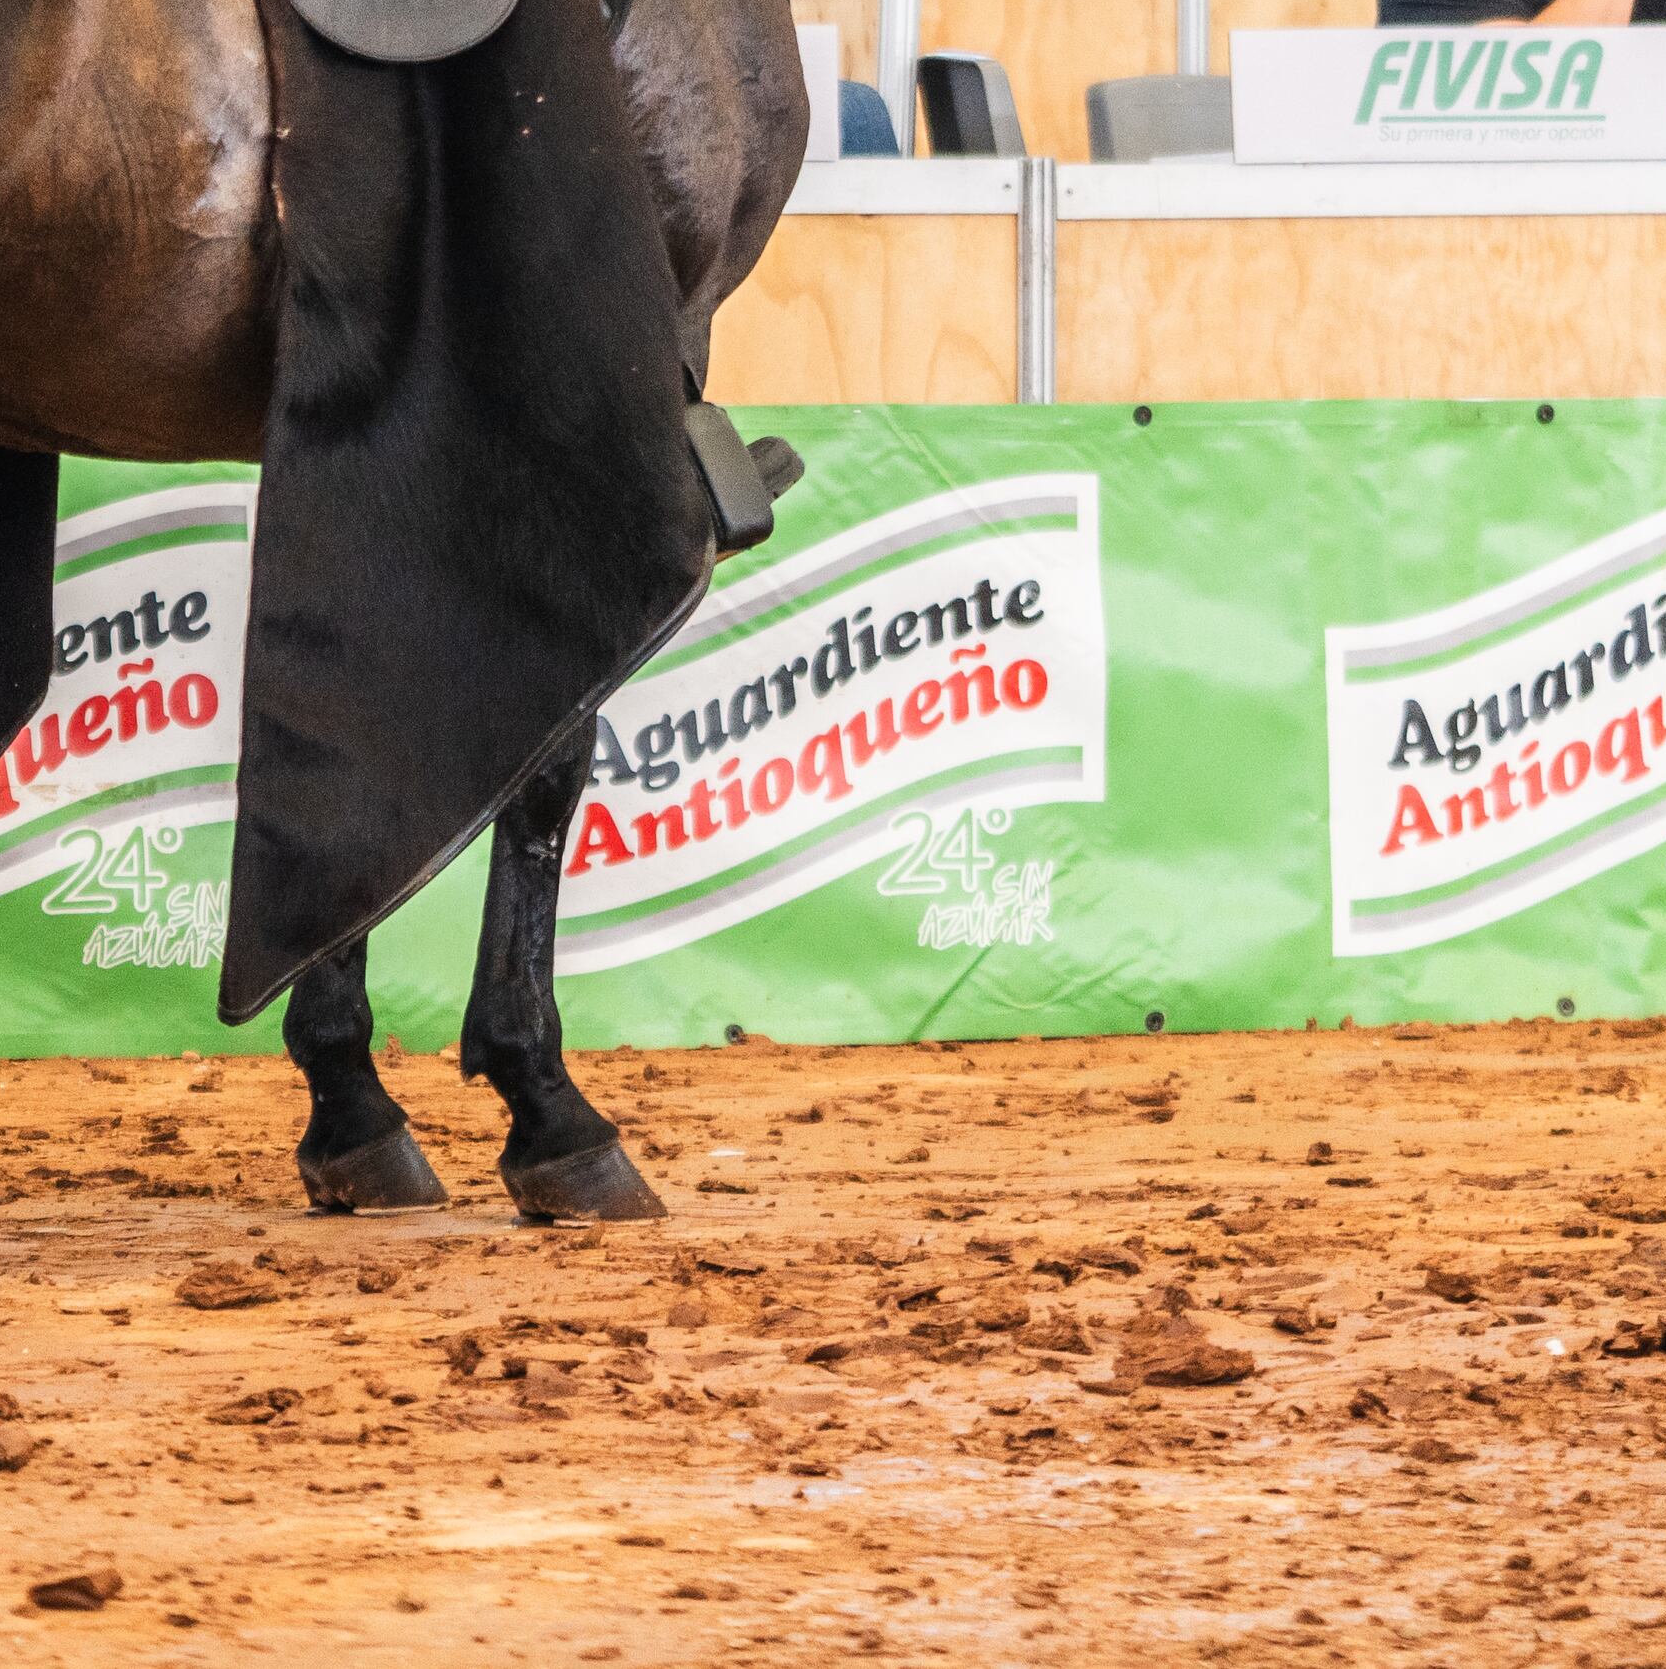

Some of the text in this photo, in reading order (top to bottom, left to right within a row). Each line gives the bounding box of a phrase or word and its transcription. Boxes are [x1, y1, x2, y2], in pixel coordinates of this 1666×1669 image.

[1354, 39, 1604, 124] FIVISA
[1379, 125, 1605, 144] Su primera y mejor opción
[587, 578, 1044, 795] Aguardiente
[564, 642, 1048, 878] Antioqueño
[165, 880, 228, 928] SIN
[993, 861, 1053, 906] SIN
[83, 912, 225, 967] AZÚCAR
[917, 892, 1053, 950] AZÚCAR
